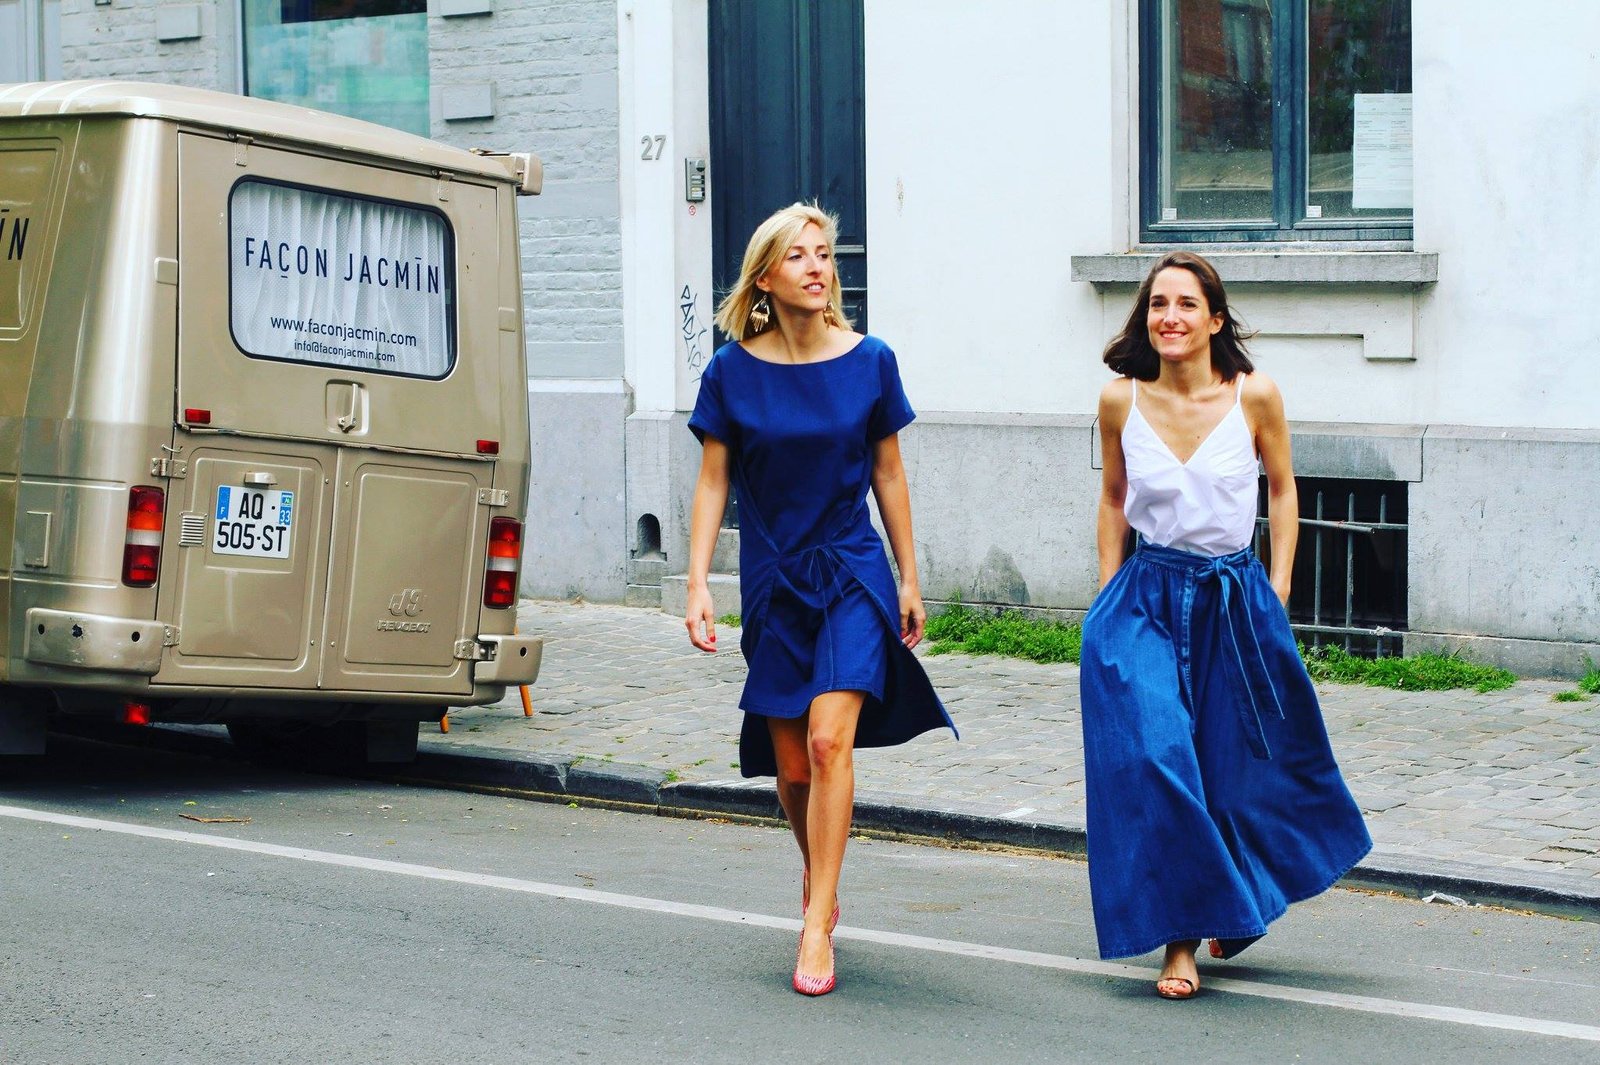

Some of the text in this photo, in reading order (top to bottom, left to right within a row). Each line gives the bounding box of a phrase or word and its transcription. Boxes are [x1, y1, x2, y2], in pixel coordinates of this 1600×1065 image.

[641, 134, 667, 161] 27
[245, 237, 328, 279] FAÇON
[270, 316, 417, 347] www.faconjacmin.com
[294, 339, 396, 363] info@faconjacmin.com
[280, 509, 291, 523] 33
[377, 619, 431, 633] PEUGEOT
